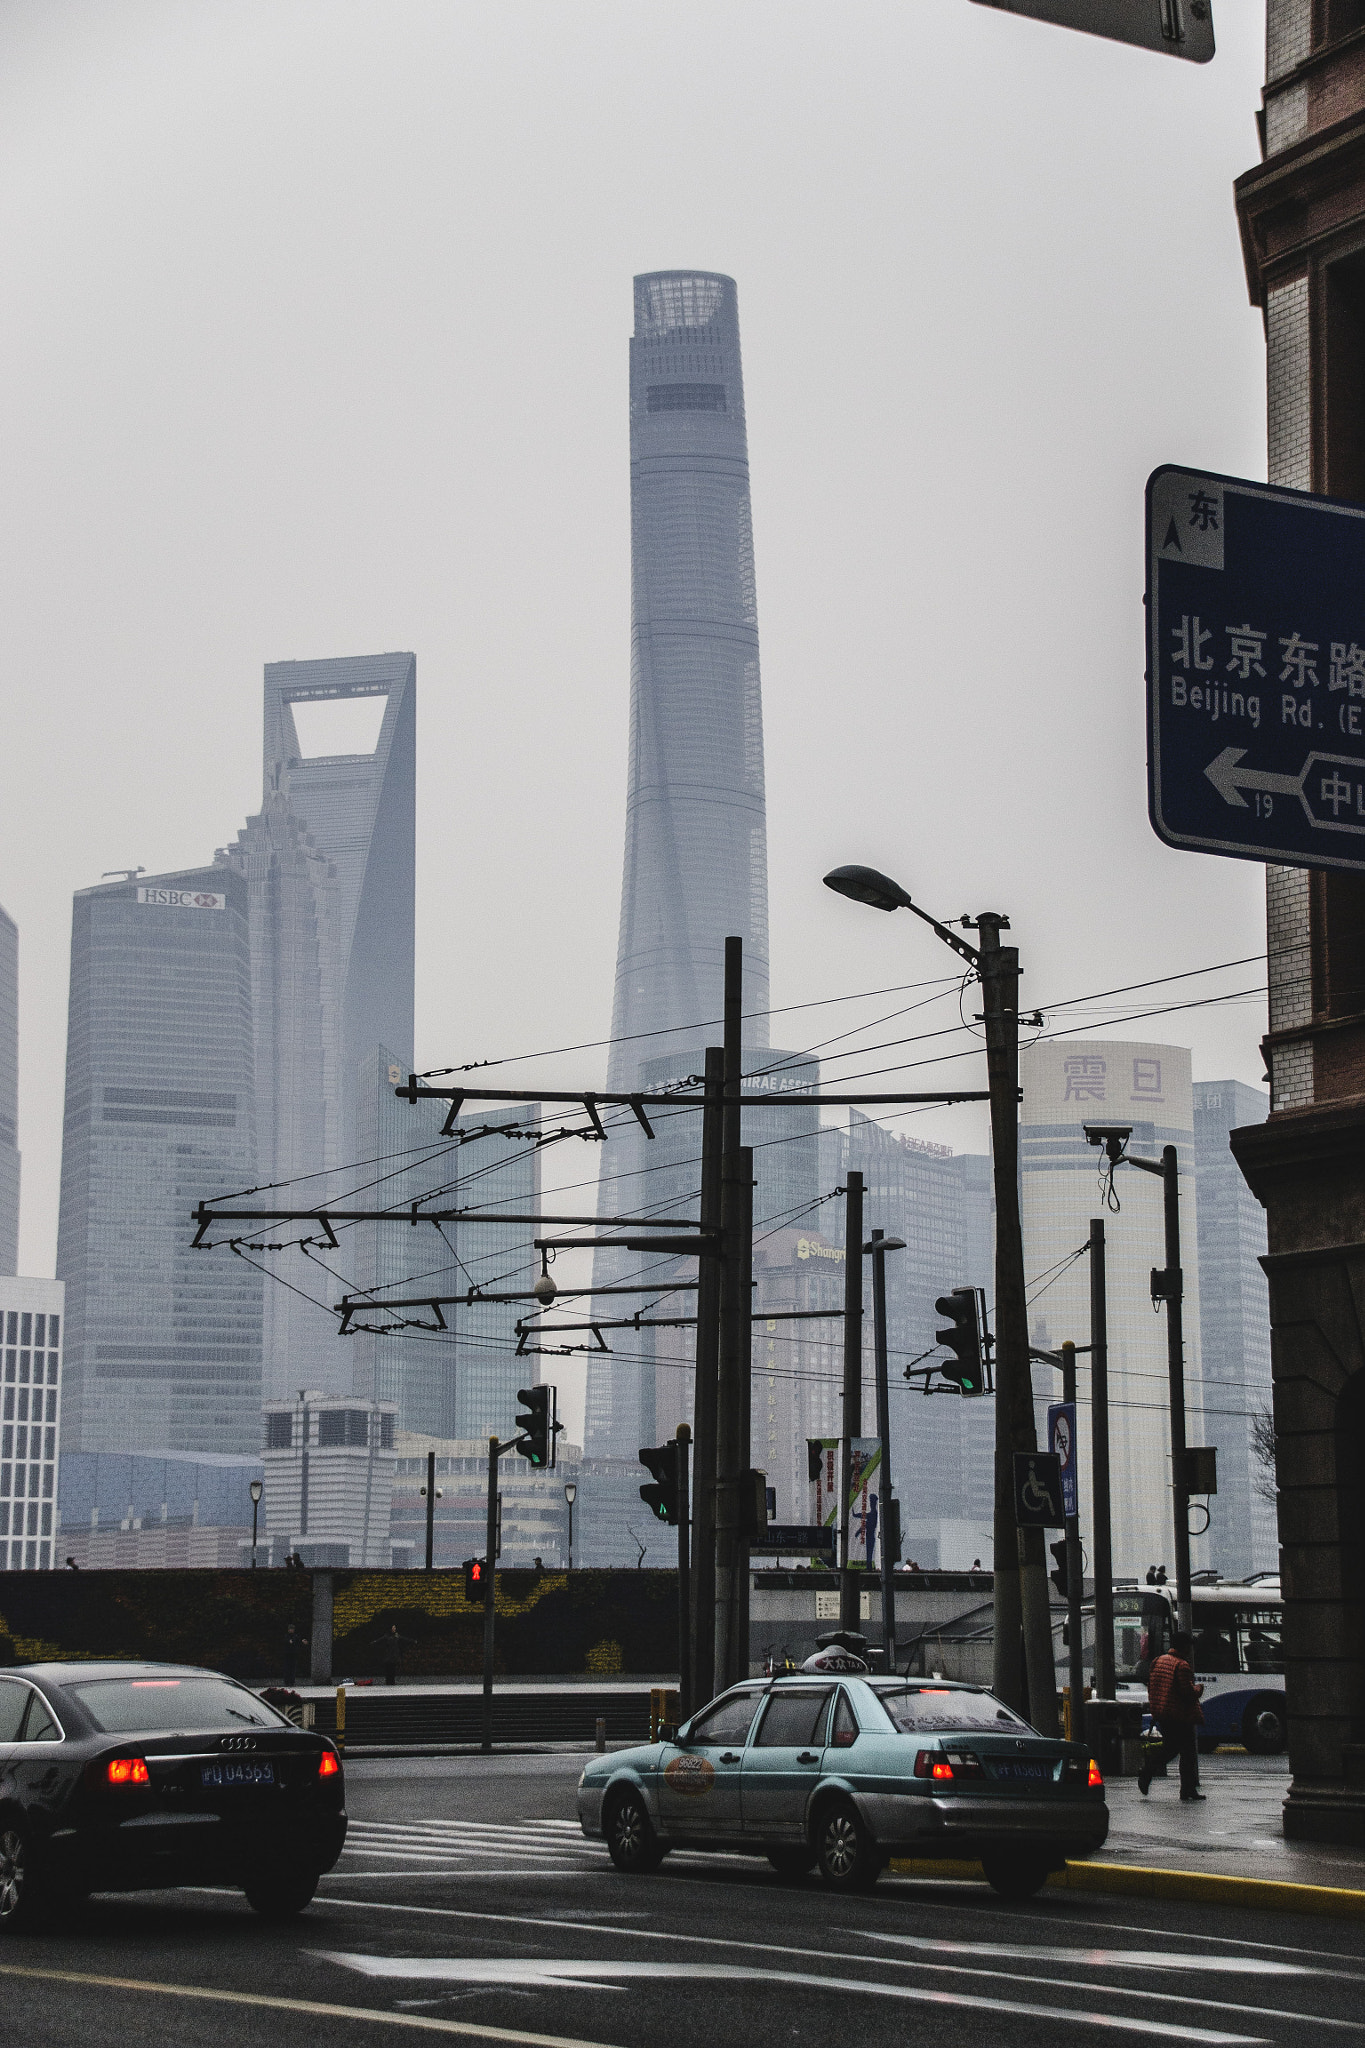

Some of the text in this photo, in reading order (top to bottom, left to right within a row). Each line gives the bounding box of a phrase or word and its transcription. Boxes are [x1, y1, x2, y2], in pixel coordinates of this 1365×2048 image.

[1187, 489, 1220, 531] 东
[1171, 614, 1365, 698] 北京东路
[1171, 675, 1261, 729] Beijing
[1255, 792, 1274, 819] 19
[145, 888, 192, 906] HSBC
[1064, 1054, 1165, 1103] 震旦
[822, 1657, 847, 1670] 大众
